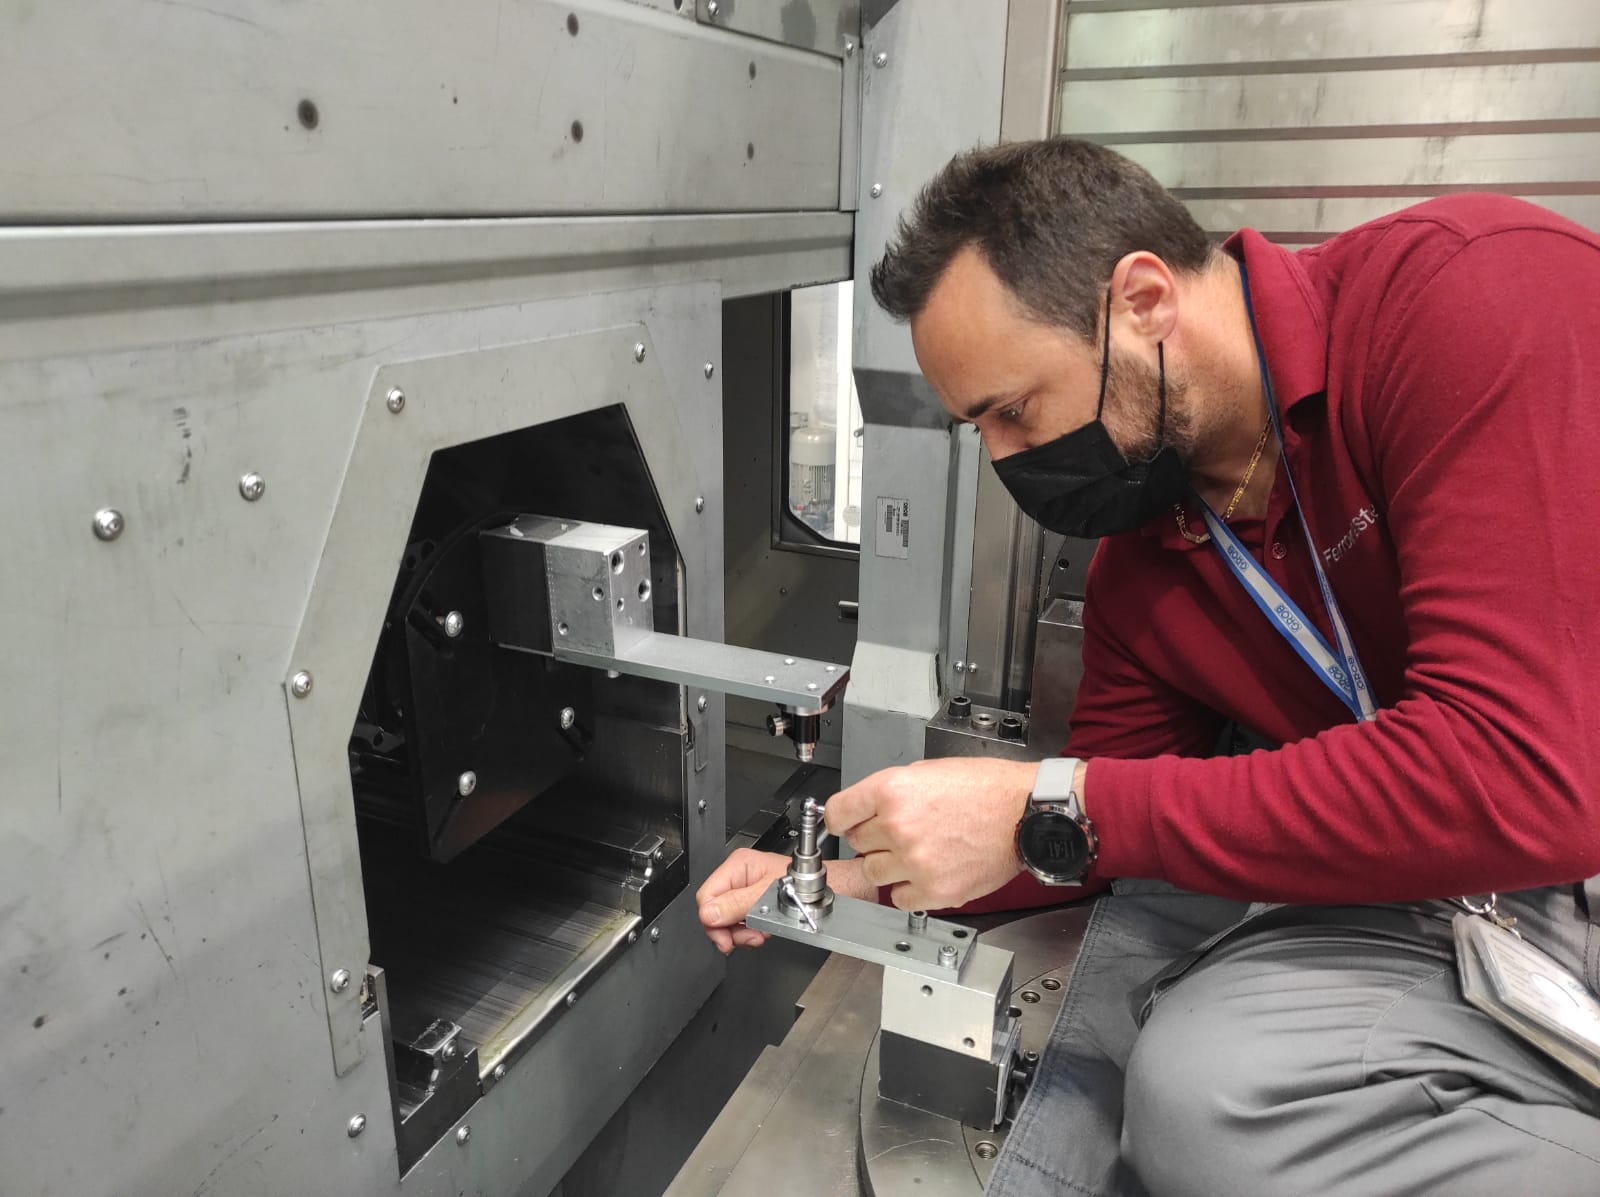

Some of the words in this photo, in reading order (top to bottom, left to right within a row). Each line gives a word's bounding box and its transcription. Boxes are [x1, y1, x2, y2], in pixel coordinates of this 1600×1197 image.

[1226, 545, 1250, 570] GROB
[1275, 604, 1302, 632] GROB
[1347, 656, 1365, 690] GROB
